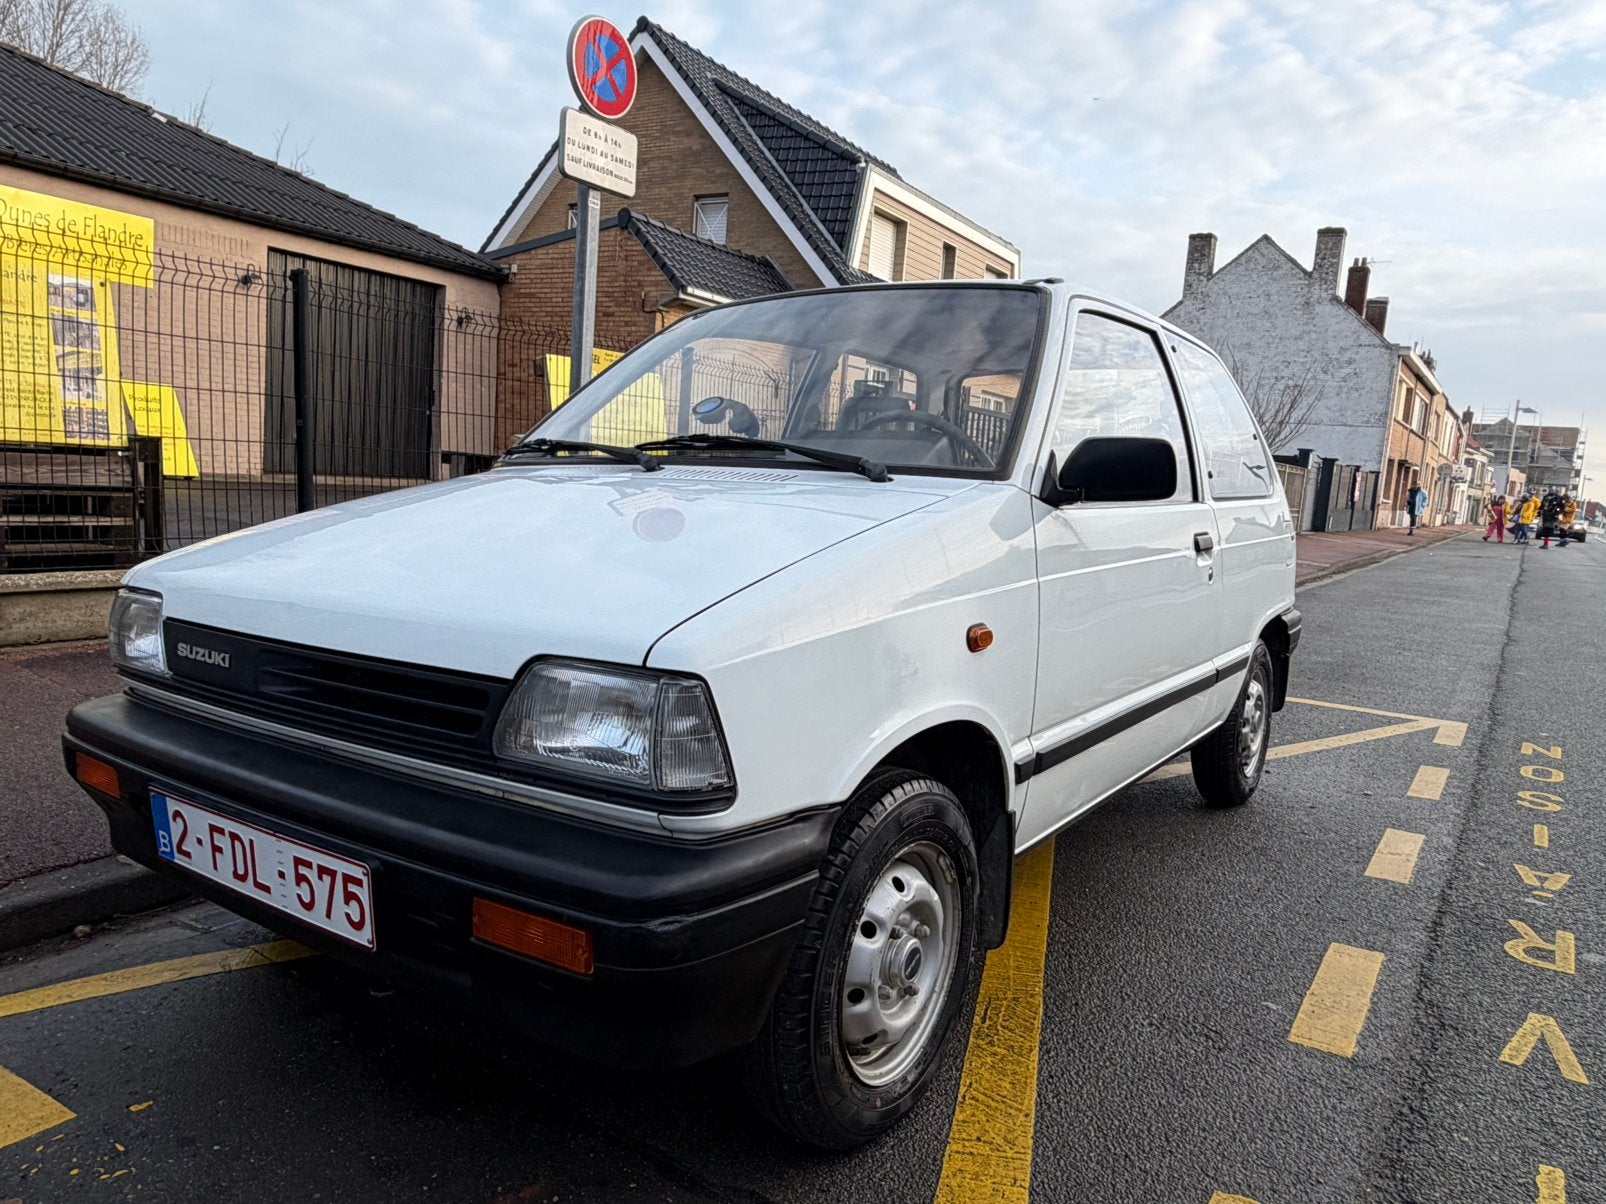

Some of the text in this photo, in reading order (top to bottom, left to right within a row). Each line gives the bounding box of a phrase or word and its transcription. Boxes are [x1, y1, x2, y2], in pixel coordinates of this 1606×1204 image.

[582, 126, 591, 136] DE
[566, 153, 614, 177] SAUF LIVRAISON
[567, 137, 635, 168] DU LUNDI AU SAMEDI
[56, 209, 77, 234] de
[83, 214, 143, 248] Flandre
[177, 642, 230, 668] SUZUKI
[159, 829, 171, 853] B
[172, 809, 366, 931] 2-FDL-575
